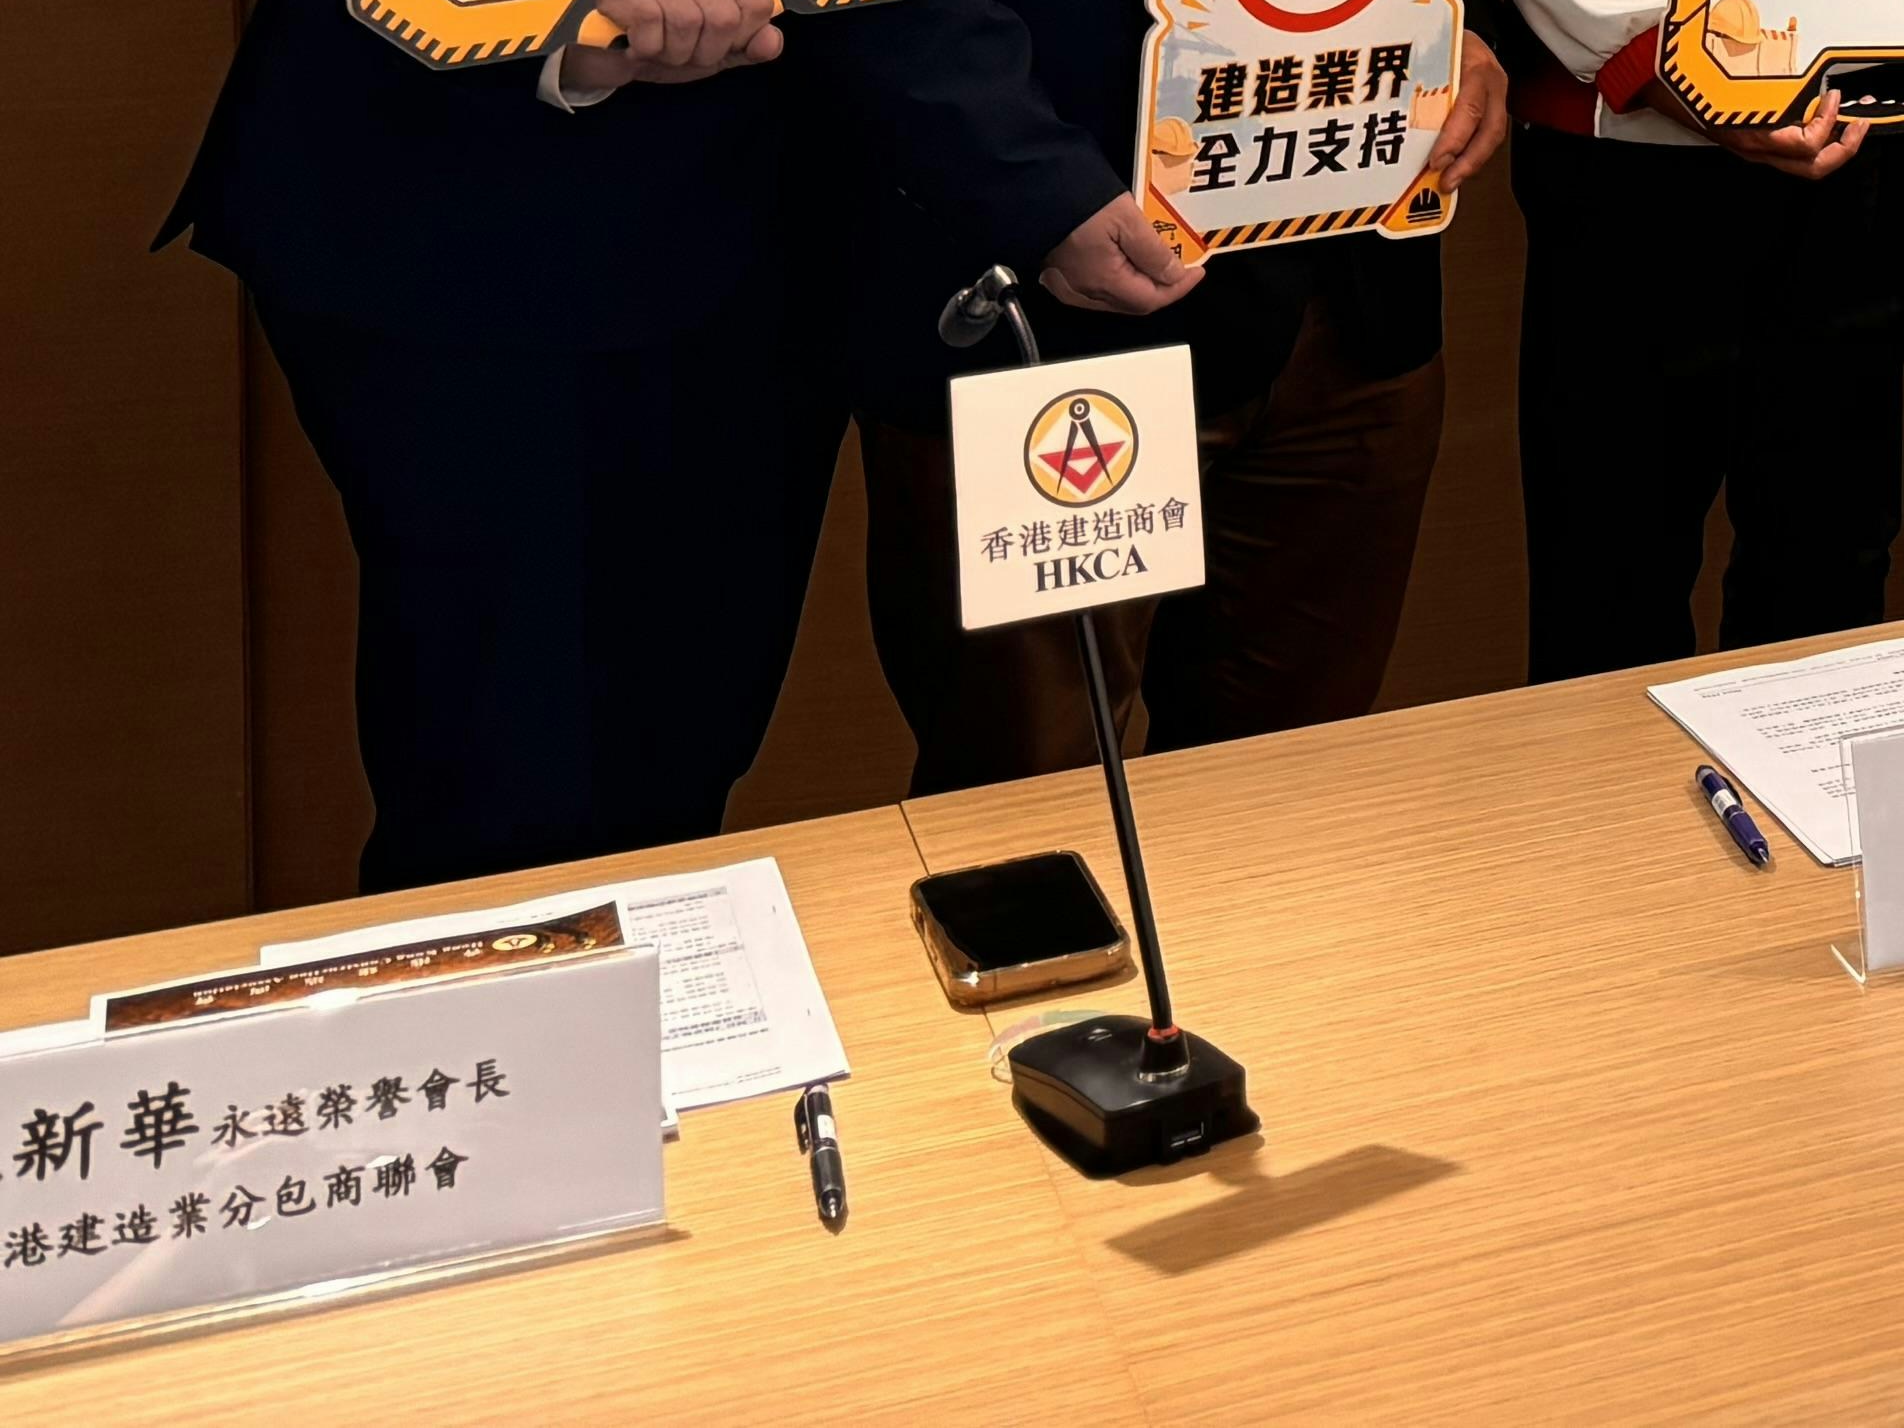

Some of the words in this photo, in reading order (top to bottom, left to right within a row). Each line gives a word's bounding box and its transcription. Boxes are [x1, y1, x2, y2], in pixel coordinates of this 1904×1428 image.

[1193, 42, 1413, 124] 建造業界
[1188, 110, 1409, 194] 全力支持
[980, 497, 1189, 563] 香港建造商會
[1034, 544, 1148, 593] HKCA
[0, 1058, 511, 1182] 新華永遠榮譽會長
[3, 1145, 470, 1269] 港建造業分包商聯會
